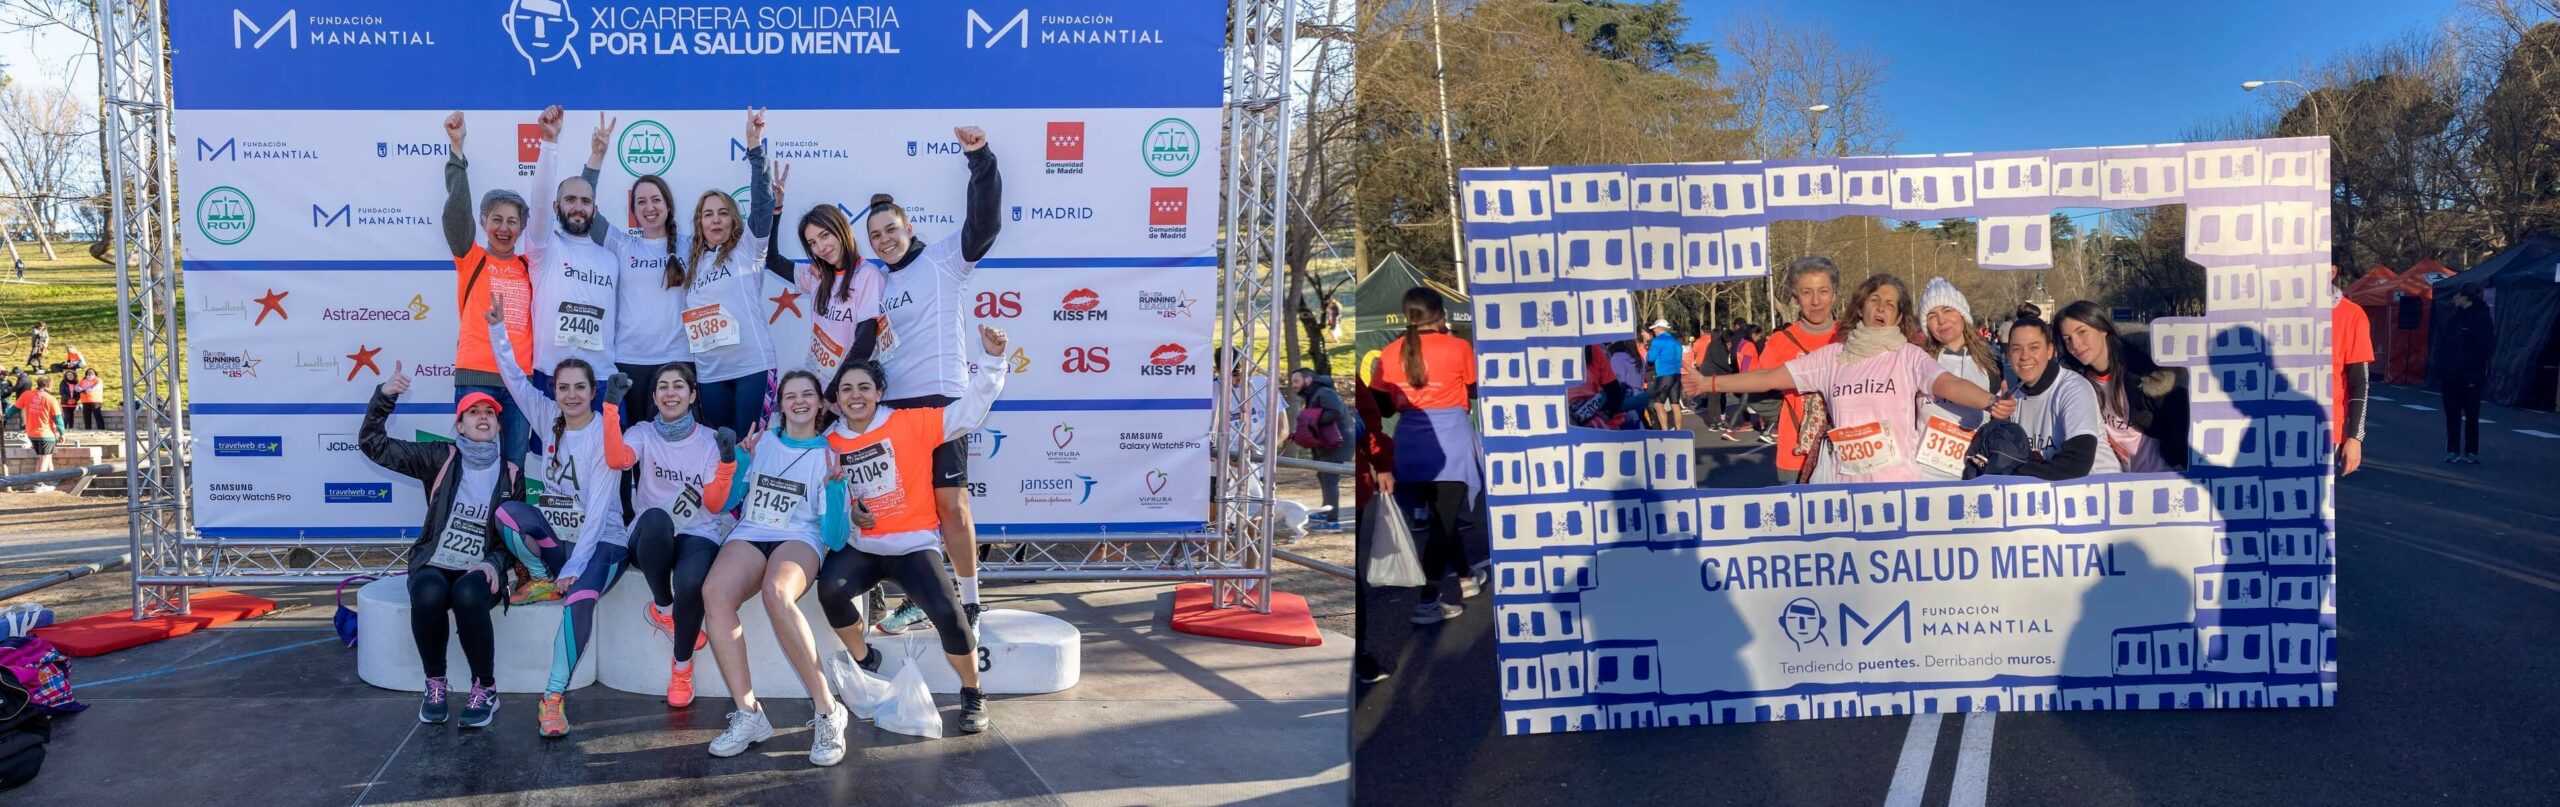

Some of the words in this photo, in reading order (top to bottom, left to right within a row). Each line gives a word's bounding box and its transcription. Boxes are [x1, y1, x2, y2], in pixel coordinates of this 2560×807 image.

[309, 14, 383, 26] FUNDACIÓN
[590, 6, 615, 30] XI
[620, 6, 751, 30] CARRERA
[757, 5, 900, 29] SOLIDARIA
[1041, 13, 1114, 25] FUNDACIÓN
[310, 30, 436, 46] MANANTIAL
[590, 32, 648, 55] POR
[654, 32, 689, 55] LA
[693, 31, 785, 55] SALUD
[791, 31, 901, 54] MENTAL
[1041, 29, 1164, 45] MANANTIAL
[242, 150, 319, 160] MANANTIAL
[775, 149, 849, 159] MANANTIAL
[927, 142, 962, 155] MAD
[627, 155, 666, 164] ROVI
[1151, 153, 1190, 162] ROVI
[908, 214, 955, 224] ANTIAL
[1031, 207, 1093, 219] MADRID
[207, 221, 246, 230] ROVI
[358, 216, 433, 225] MANANTIAL
[630, 255, 687, 269] analiA
[973, 291, 1023, 319] as
[322, 308, 411, 321] AstraZeneca
[1053, 310, 1084, 321] KISS
[1087, 310, 1108, 321] FM
[1163, 310, 1177, 318] as
[559, 315, 594, 335] 2440
[690, 318, 720, 341] 3138
[1061, 346, 1111, 374] as
[1140, 364, 1172, 376] KISS
[1175, 364, 1196, 376] FM
[1119, 432, 1163, 440] SAMSUNG
[326, 441, 360, 452] JCDec
[1119, 441, 1151, 451] Galaxy
[1151, 441, 1184, 450] Watch5
[1185, 441, 1201, 449] Pro
[1838, 440, 1875, 462] 3230
[1927, 432, 1966, 460] 3138
[847, 461, 883, 485] 2104
[209, 483, 253, 491] SAMSUNG
[209, 492, 241, 503] Galaxy
[242, 492, 276, 501] Watch5
[277, 492, 292, 501] Pro
[753, 489, 791, 514] 2145
[442, 531, 483, 557] 2225
[1700, 551, 1860, 592] CARRERA
[1869, 546, 1980, 585] SALUD
[1991, 542, 2127, 580] MENTAL
[1921, 603, 2000, 617] FUNDACIÓN
[1922, 618, 2054, 637] MANANTIAL
[977, 646, 992, 673] 3
[1779, 658, 1854, 675] Tendiendo
[1858, 657, 1920, 674] puentes.
[1924, 653, 2003, 669] Derribando
[2007, 653, 2057, 667] muros.
